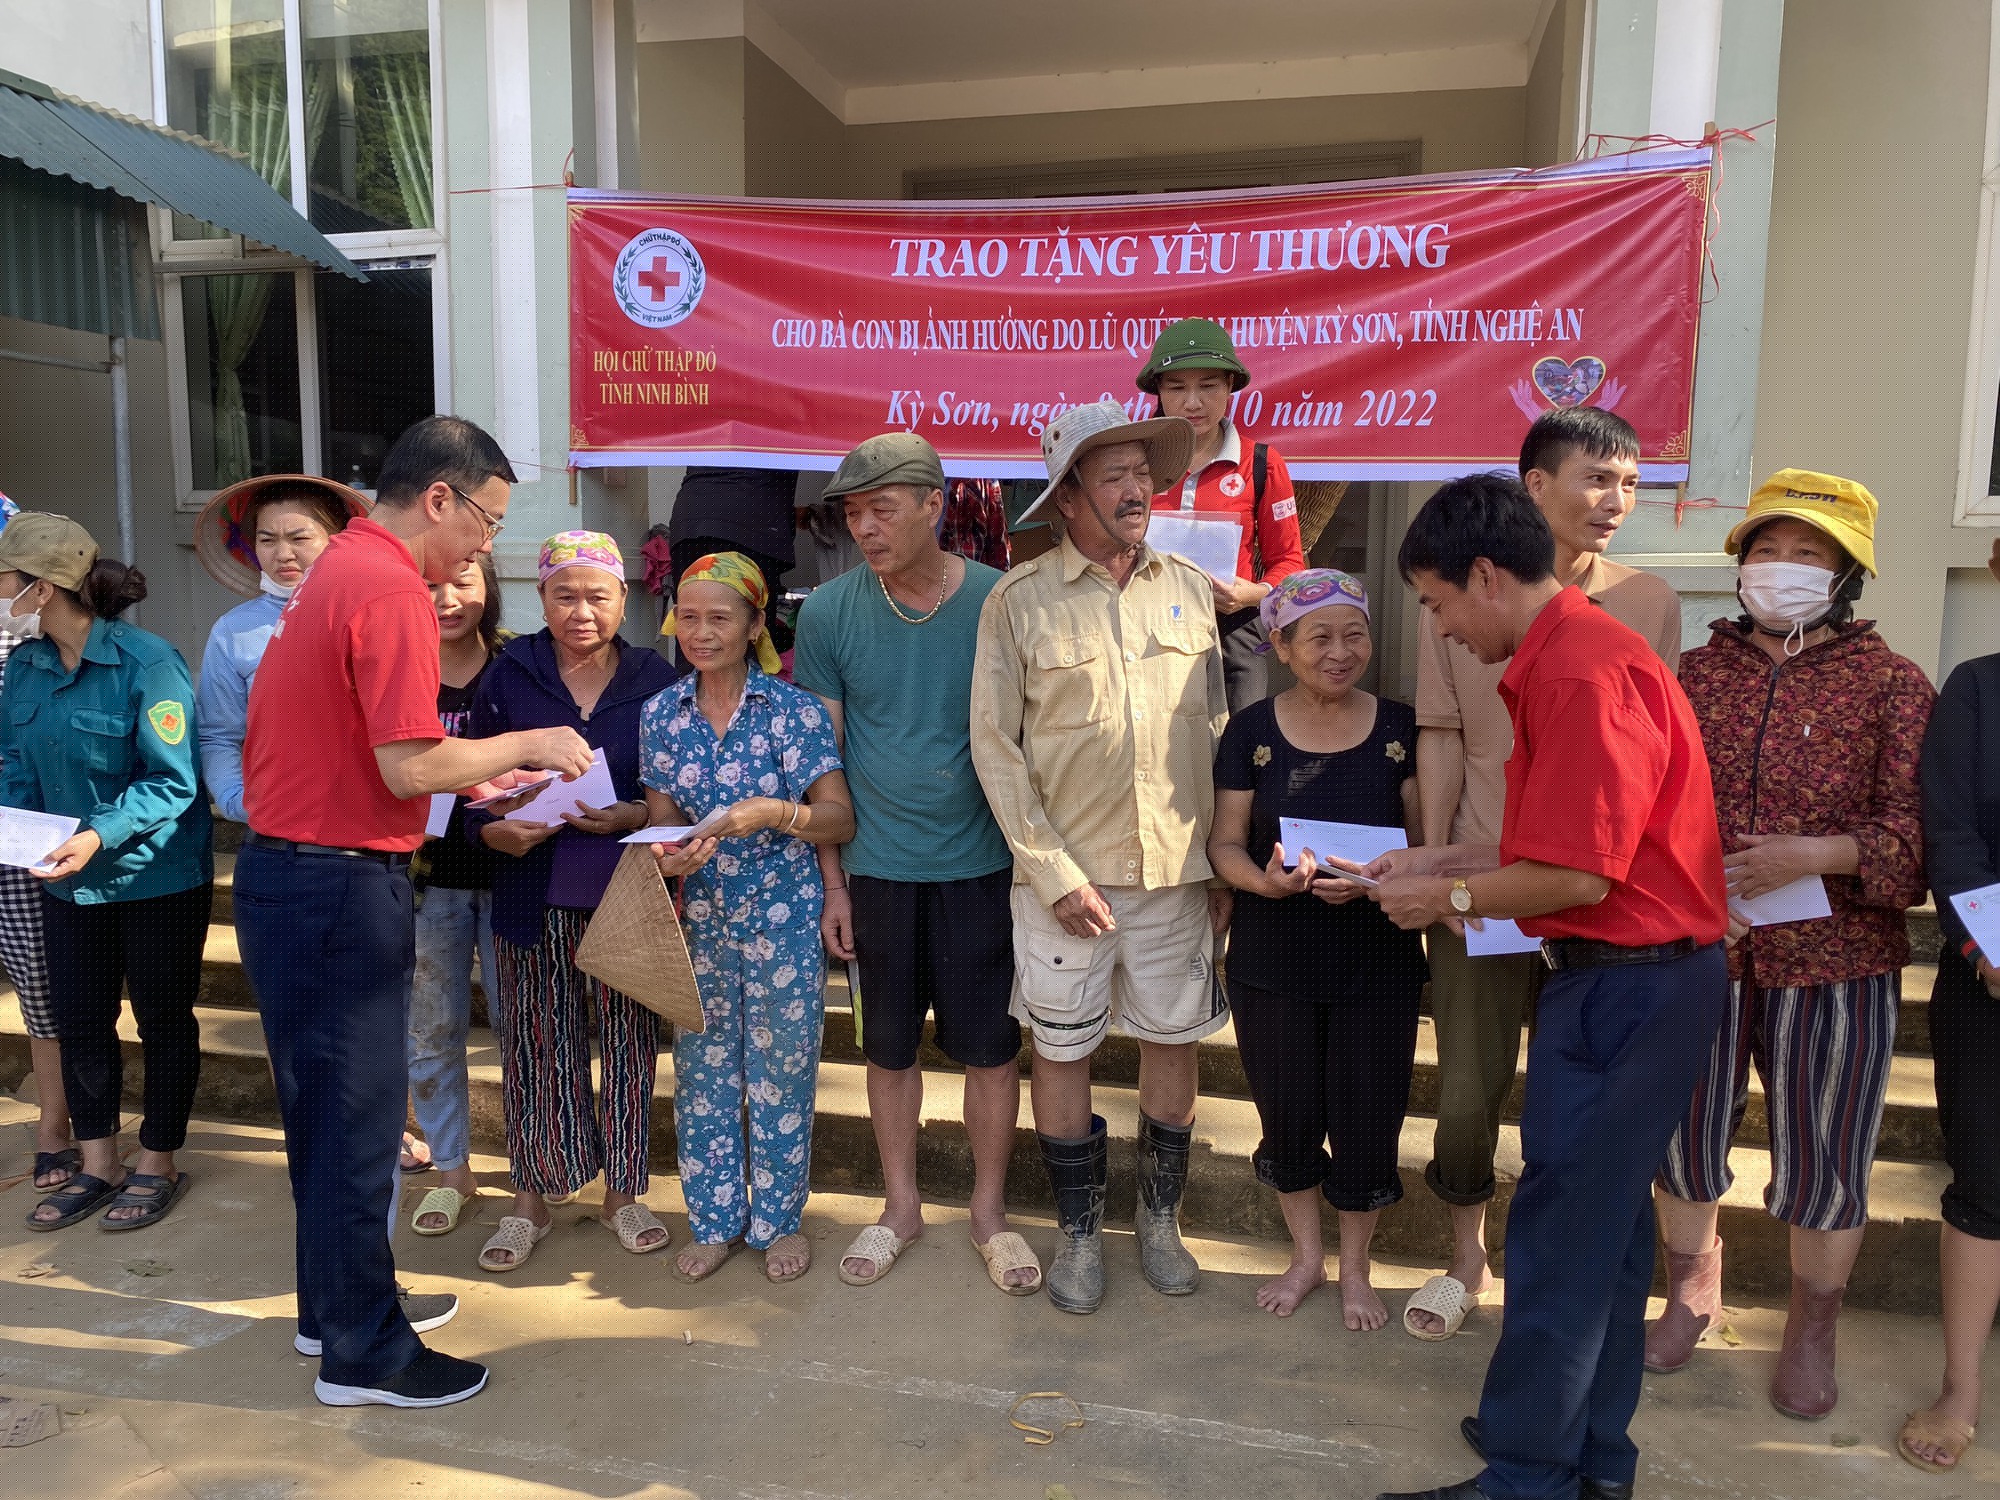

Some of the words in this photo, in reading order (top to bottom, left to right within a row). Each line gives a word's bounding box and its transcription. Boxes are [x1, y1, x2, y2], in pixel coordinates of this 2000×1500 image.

[889, 238, 1008, 278] TRAO
[1019, 226, 1138, 284] TẶNG
[1149, 222, 1241, 275] YÊU
[1250, 219, 1450, 272] THƯƠNG
[772, 318, 816, 349] CHO
[819, 309, 847, 348] BÀ
[852, 319, 894, 350] CON
[898, 319, 919, 356] BỊ
[923, 305, 968, 350] ẢNH
[972, 305, 1048, 351] HƯỞNG
[1052, 318, 1084, 351] DO
[1088, 311, 1117, 351] LŨ
[1231, 307, 1310, 351] HUYỆN
[1313, 304, 1348, 345] KỲ
[1351, 312, 1404, 350] SƠN,
[1410, 298, 1469, 342] TỈNH
[1472, 299, 1543, 347] NGHỆ
[1547, 308, 1585, 341] AN
[622, 345, 653, 372] CHỮ
[695, 345, 717, 372] ĐỎ
[636, 384, 670, 404] NINH
[675, 377, 709, 405] BÌNH
[884, 390, 925, 433] Kỳ
[932, 391, 999, 433] Sơn,
[1227, 390, 1263, 427] 10
[1271, 390, 1343, 428] năm
[1354, 389, 1437, 428] 2022
